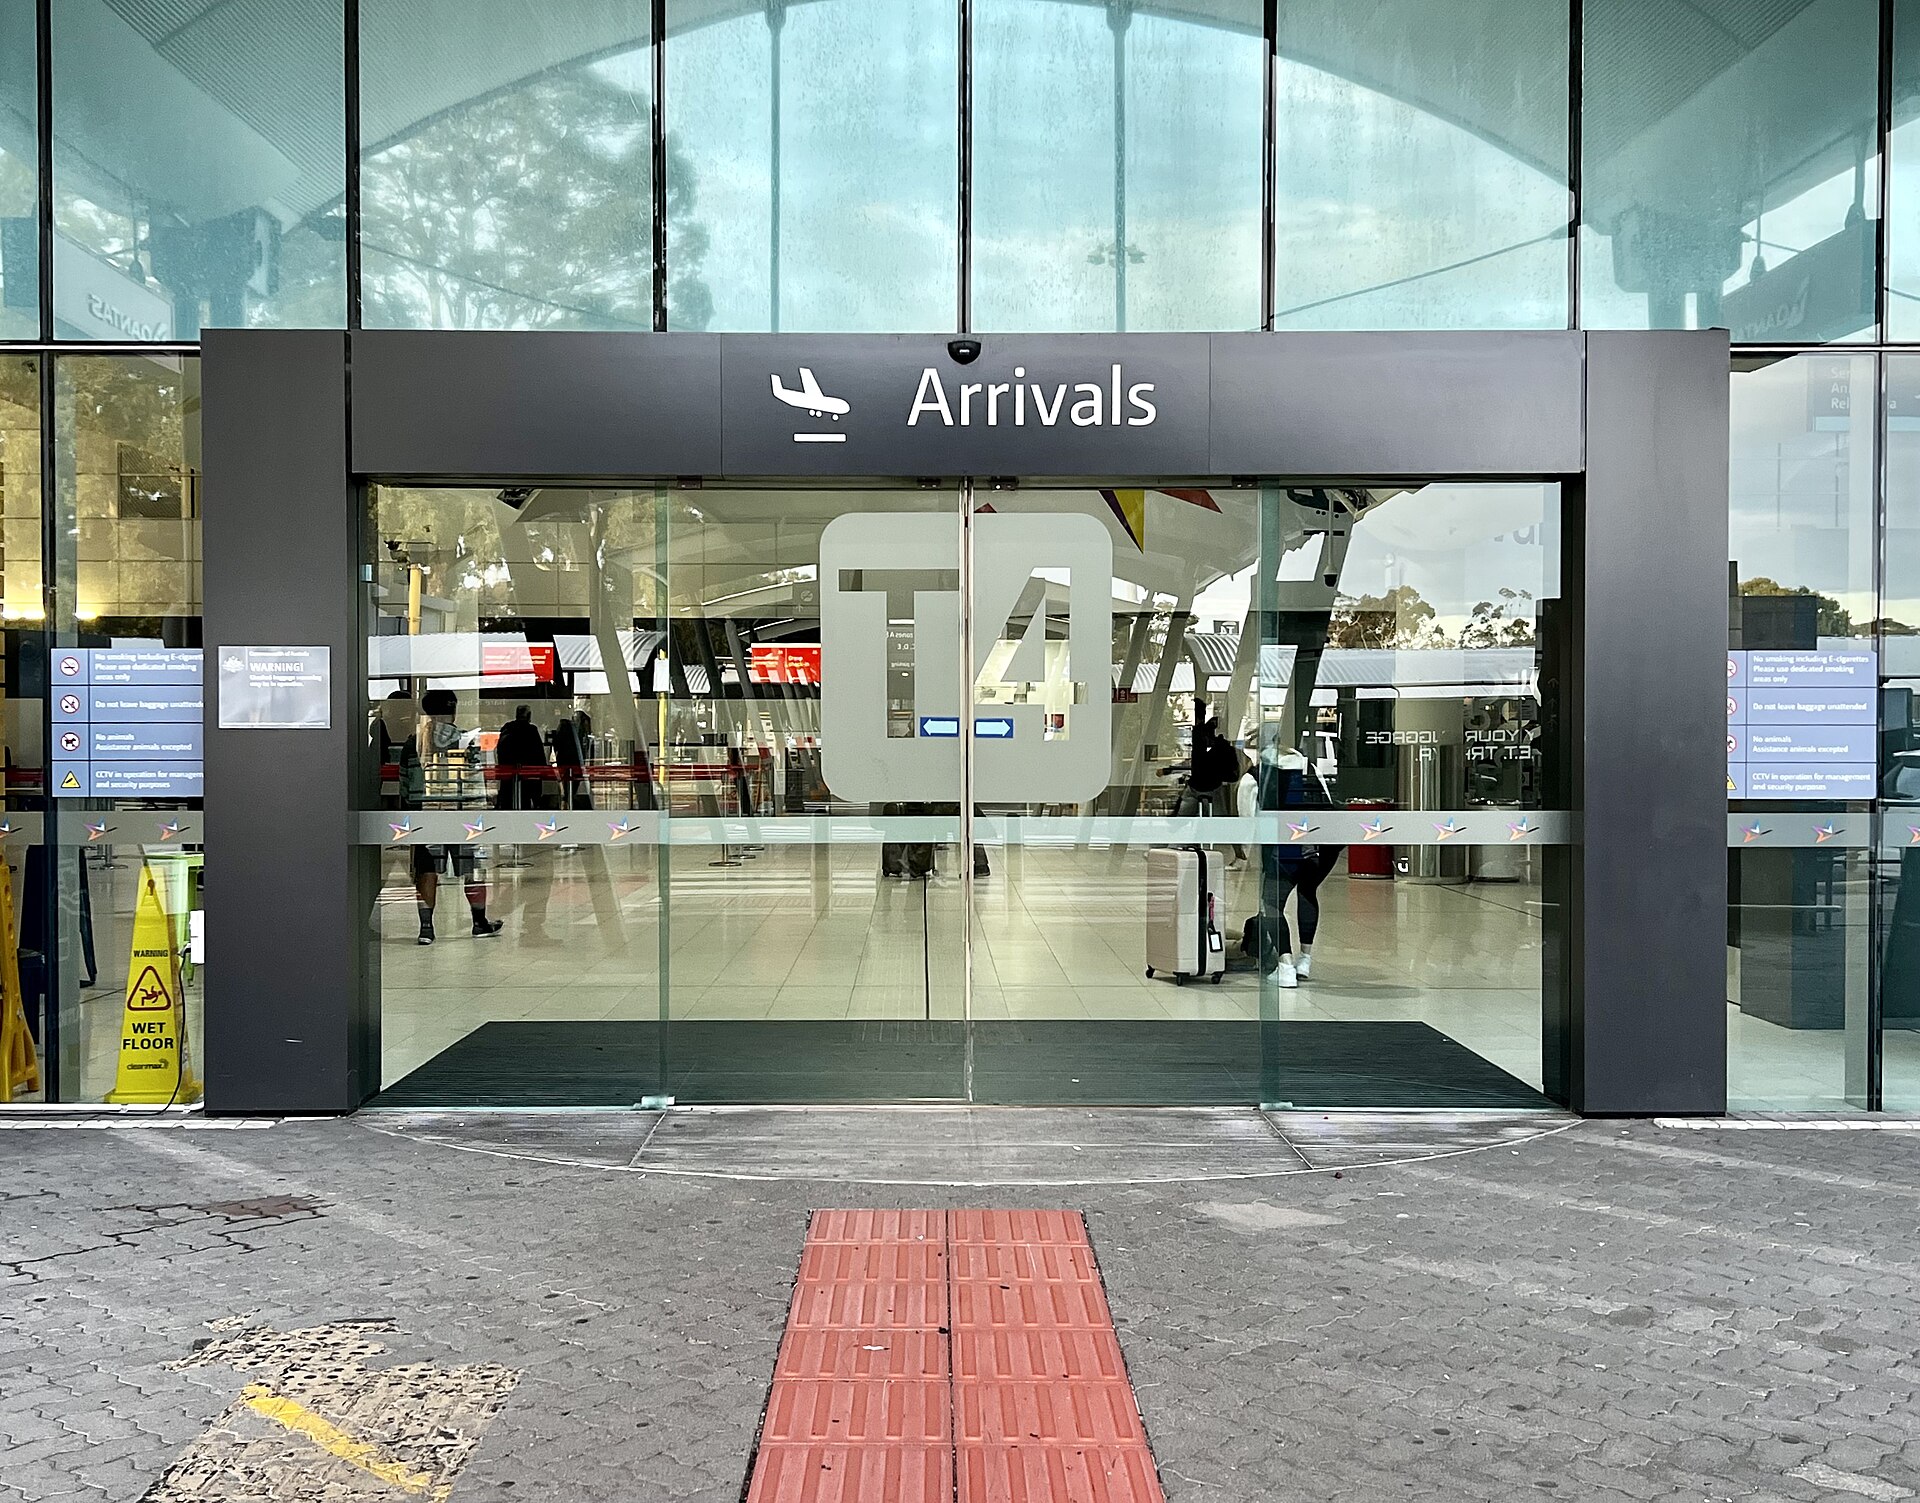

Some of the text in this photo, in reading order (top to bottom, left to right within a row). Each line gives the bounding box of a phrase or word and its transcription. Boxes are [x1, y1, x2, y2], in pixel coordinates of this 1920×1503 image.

[907, 364, 1157, 427] Arrivals
[95, 653, 106, 661] No
[106, 653, 137, 662] smoking
[137, 653, 170, 662] including
[838, 566, 1089, 740] T4
[1753, 655, 1869, 664] No smoking including E-cigarettes
[95, 663, 118, 671] Please
[132, 663, 166, 671] dedicated
[166, 663, 197, 672] smoking
[249, 662, 304, 672] WARNING!
[1753, 665, 1775, 673] Please
[1790, 665, 1824, 673] dedicated
[1824, 665, 1855, 674] smoking
[114, 673, 131, 682] only
[1772, 675, 1788, 684] only
[95, 700, 106, 708] Do
[120, 700, 139, 708] leave
[139, 700, 169, 710] baggage
[1753, 702, 1763, 710] Do
[1778, 702, 1796, 710] leave
[1796, 702, 1826, 712] baggage
[1827, 702, 1867, 710] unattended
[95, 733, 135, 741] No animals
[1752, 735, 1792, 743] No animals
[95, 743, 193, 752] Assistance animals excepted
[1752, 745, 1849, 754] Assistance animals excepted
[95, 770, 114, 778] CCTV
[123, 771, 157, 780] operation
[158, 770, 168, 778] for
[1752, 772, 1870, 782] CCTV in operation for management
[96, 780, 171, 790] and security purposes
[1752, 783, 1827, 792] and security purposes
[133, 950, 169, 958] WARNING
[132, 1022, 166, 1034] WET
[123, 1038, 174, 1050] FLOOR
